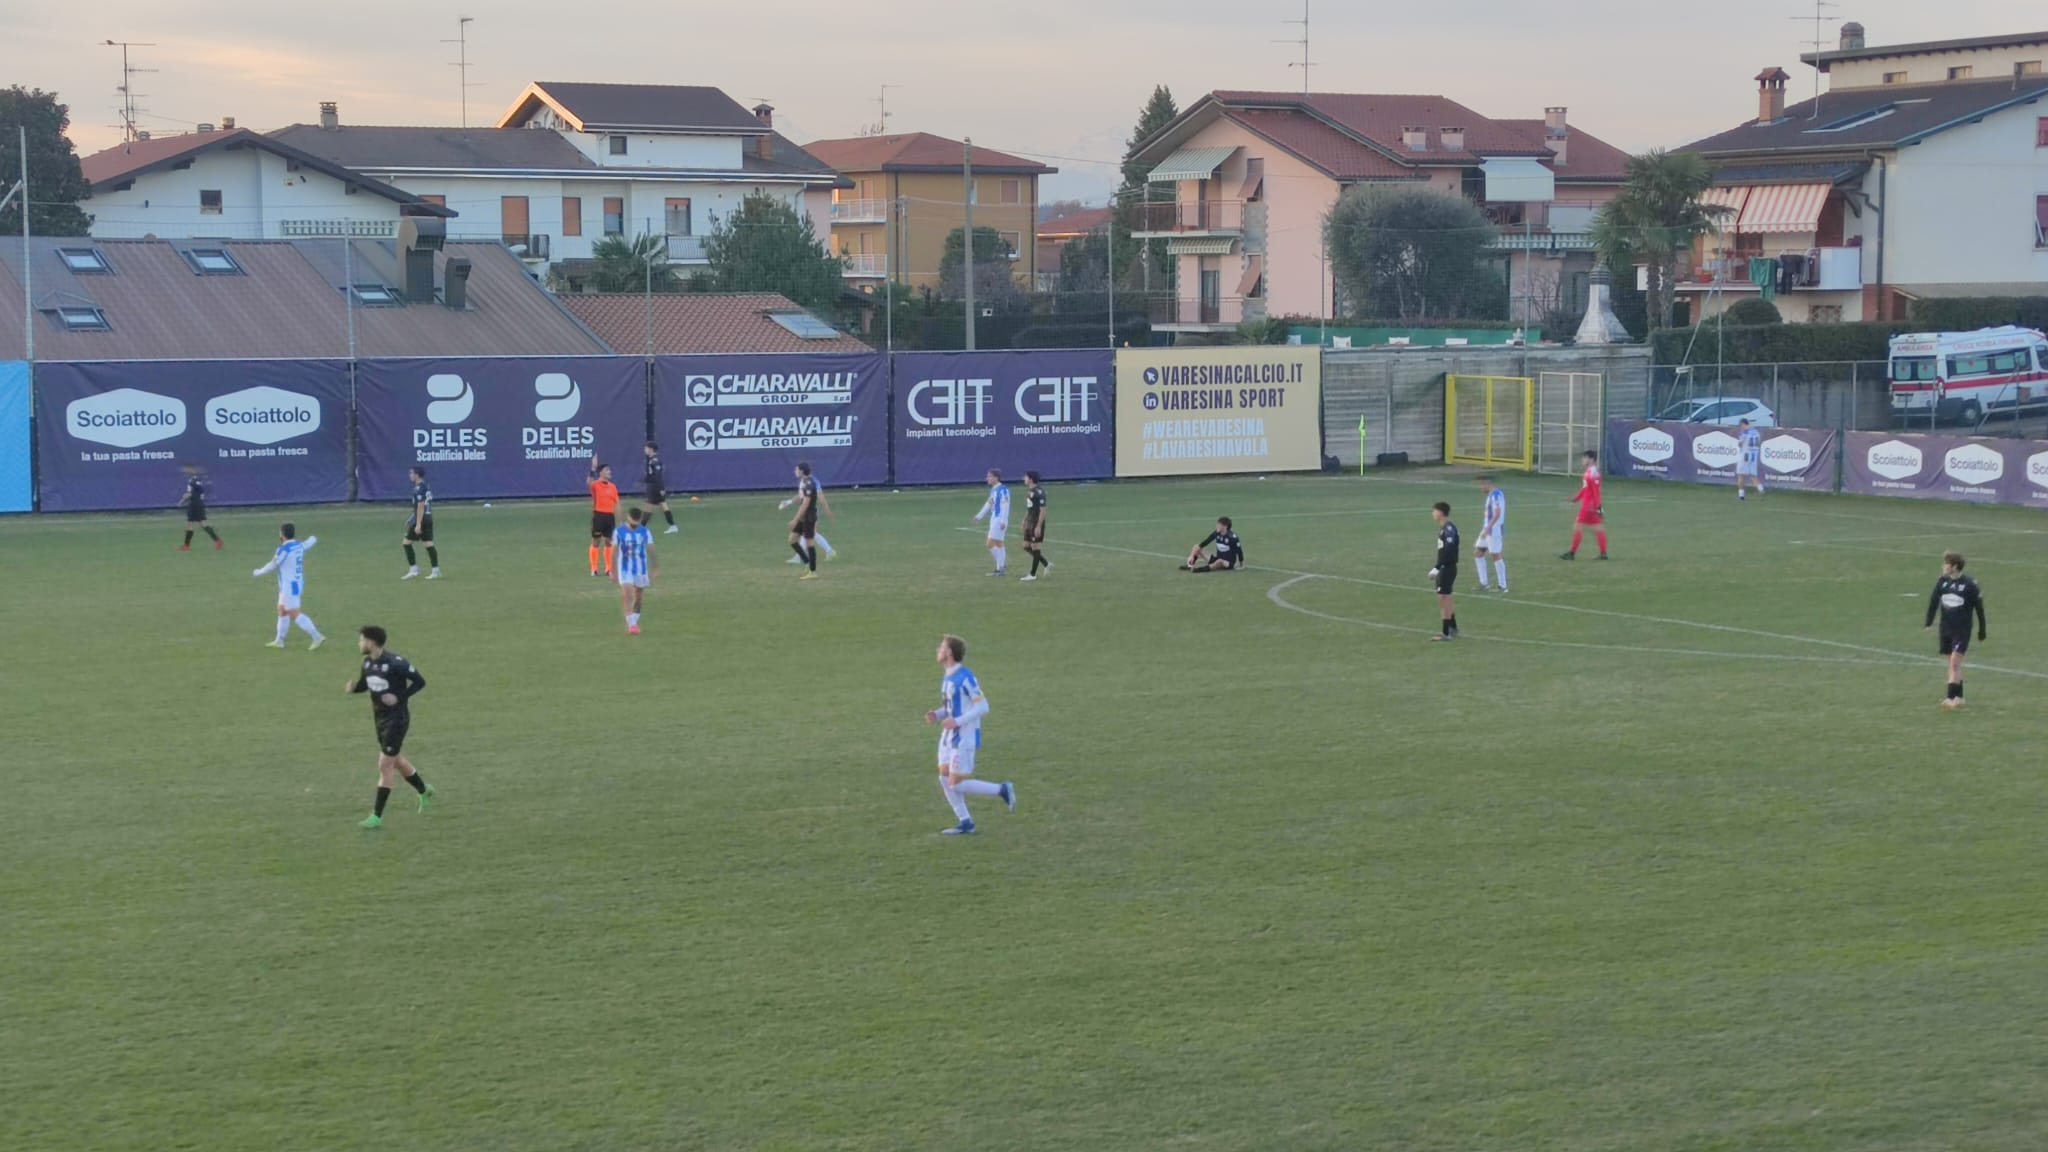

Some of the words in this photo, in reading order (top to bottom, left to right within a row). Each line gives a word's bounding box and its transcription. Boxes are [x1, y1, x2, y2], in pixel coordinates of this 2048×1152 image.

[1161, 363, 1303, 386] VARESINACALCIO.IT
[760, 394, 809, 404] GROUP
[1161, 390, 1233, 410] VARESINA
[1239, 388, 1285, 408] SPORT
[77, 409, 177, 428] Scoiattolo
[215, 406, 311, 425] Scoiattolo
[906, 426, 944, 439] impianti
[945, 426, 996, 438] tecnologici
[1013, 425, 1050, 436] impianti
[1051, 423, 1101, 435] tecnologici
[1143, 417, 1265, 440] #WEAREVARESINA
[413, 428, 488, 448] DELES
[522, 426, 595, 446] DELES
[761, 437, 809, 447] GROUP
[219, 448, 229, 457] la
[230, 448, 247, 457] tua
[248, 447, 276, 459] pasta
[278, 446, 309, 456] fresca
[1143, 437, 1269, 460] #LAVARESINAVOLA
[1632, 439, 1671, 452] Scoiattolo
[81, 452, 91, 461] la
[93, 452, 110, 461] tua
[112, 451, 141, 463] pasta
[142, 449, 175, 460] fresca
[416, 449, 463, 462] Scatolificio
[463, 449, 487, 461] Deles
[525, 447, 571, 460] Scatolificio
[571, 446, 593, 459] Deles
[1764, 447, 1807, 461] Scoiattolo
[1871, 453, 1918, 467] Scoiattolo
